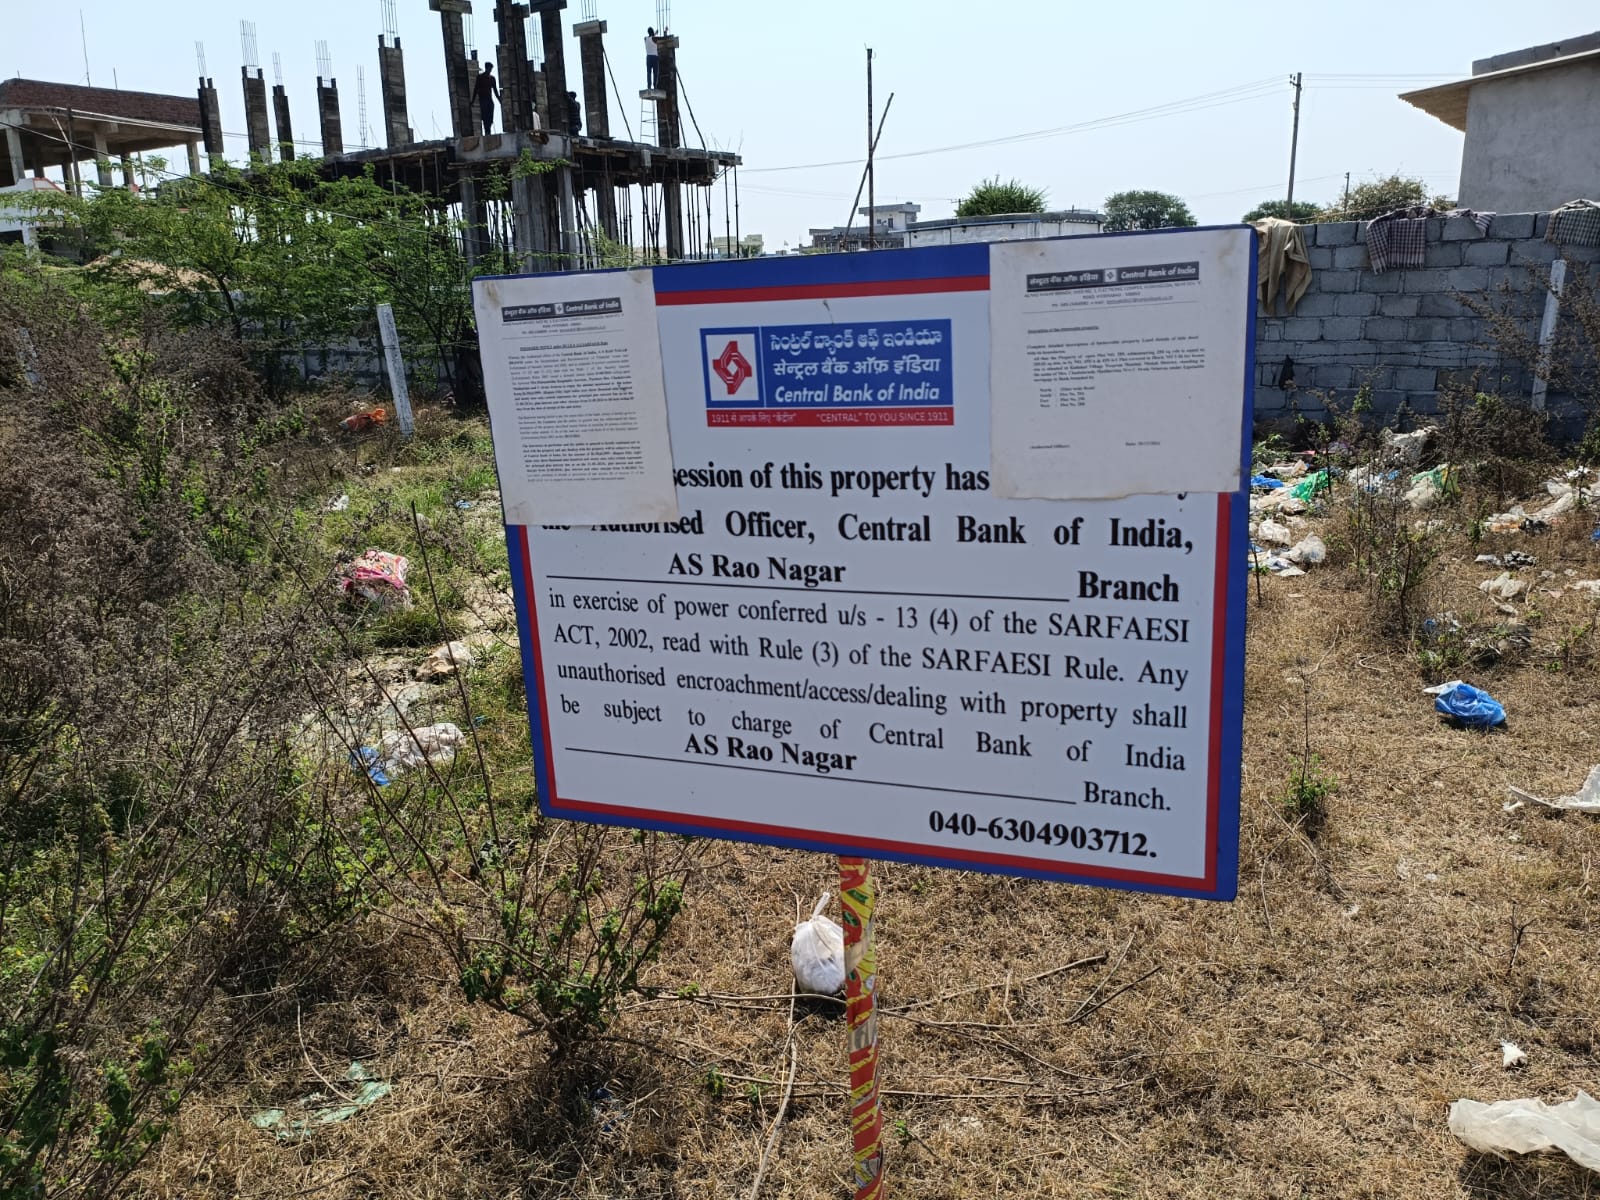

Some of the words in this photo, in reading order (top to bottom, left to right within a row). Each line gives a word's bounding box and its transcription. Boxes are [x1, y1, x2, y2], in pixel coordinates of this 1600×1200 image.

[1121, 269, 1146, 279] Central
[1148, 267, 1166, 277] Bank
[1168, 267, 1176, 276] of
[1177, 265, 1196, 275] India
[821, 356, 850, 375] बैंक
[893, 354, 941, 374] इंडिया
[775, 383, 828, 403] Central
[832, 384, 872, 402] Bank
[877, 381, 896, 401] of
[898, 382, 940, 402] India
[712, 414, 730, 423] 1911
[865, 412, 876, 422] TO
[878, 412, 897, 422] YOU
[899, 412, 926, 422] SINCE
[928, 411, 948, 422] 1911
[750, 462, 774, 488] of
[780, 463, 822, 489] this
[831, 467, 935, 497] property
[946, 463, 989, 490] has
[726, 511, 814, 544] Officer,
[838, 514, 930, 541] Central
[958, 516, 1026, 543] Bank
[1054, 517, 1084, 545] of
[1109, 518, 1192, 554] India,
[669, 553, 703, 576] AS
[712, 555, 759, 578] Rao
[768, 557, 846, 587] Nagar
[1078, 571, 1179, 602] Branch
[550, 588, 565, 607] in
[573, 592, 638, 612] exercise
[648, 593, 666, 613] of
[674, 601, 729, 620] power
[738, 600, 827, 623] conferred
[839, 605, 866, 625] u/s
[898, 607, 917, 628] 13
[930, 609, 958, 635] (4)
[970, 610, 994, 631] of
[1004, 611, 1037, 634] the
[1049, 613, 1189, 642] SARFAESI
[554, 624, 599, 648] ACT,
[608, 627, 653, 652] 2002,
[663, 633, 700, 652] read
[710, 634, 748, 656] with
[759, 638, 802, 660] Rule
[813, 642, 838, 667] (3)
[849, 644, 871, 664] of
[880, 645, 911, 667] the
[923, 648, 1050, 676] SARFAESI
[1065, 656, 1123, 681] Rule.
[1138, 661, 1188, 691] Any
[558, 663, 665, 686] unauthorised
[677, 674, 947, 714] encroachment/access/dealing
[960, 691, 1006, 714] with
[1021, 701, 1117, 728] property
[1133, 703, 1186, 728] shall
[560, 694, 579, 714] be
[604, 700, 662, 724] subject
[688, 709, 705, 726] to
[732, 711, 791, 738] charge
[820, 719, 841, 739] of
[869, 723, 943, 748] Central
[977, 732, 1032, 756] Bank
[1067, 740, 1092, 761] of
[1126, 744, 1185, 770] India
[685, 734, 718, 755] AS
[727, 737, 773, 761] Rao
[781, 742, 857, 773] Nagar
[1084, 781, 1170, 811] Branch.
[929, 811, 1156, 857] 040-6304903712.
